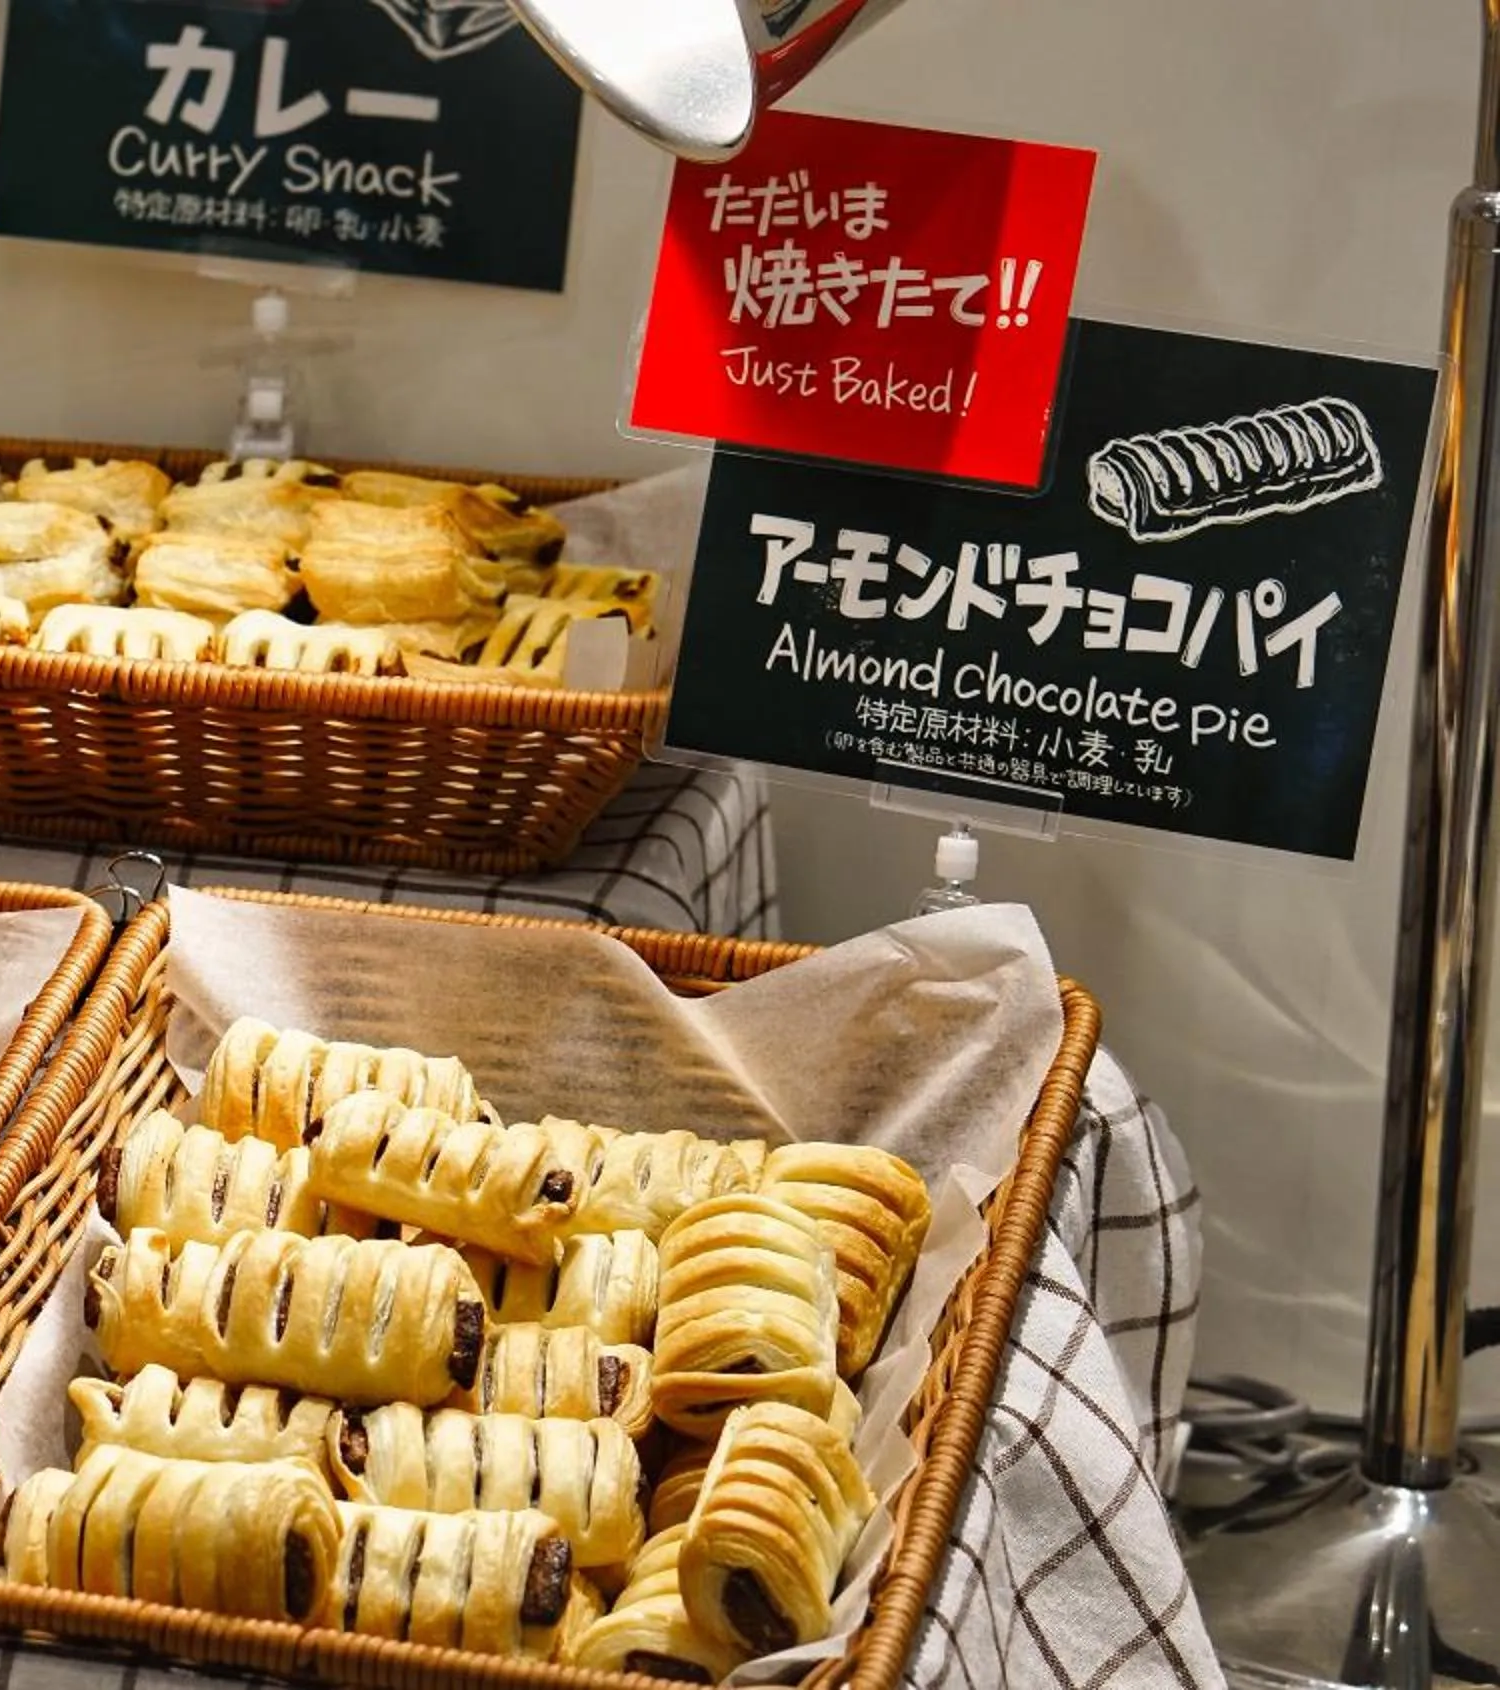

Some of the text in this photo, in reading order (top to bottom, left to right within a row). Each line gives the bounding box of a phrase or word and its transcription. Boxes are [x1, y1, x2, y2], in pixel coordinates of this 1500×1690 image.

[144, 24, 440, 138] カレー
[108, 125, 461, 207] Curry Snack
[704, 168, 890, 241] ただいま
[720, 345, 818, 397] Just
[749, 513, 1343, 689] アーモンドチョコパイ
[765, 622, 944, 699] Almond
